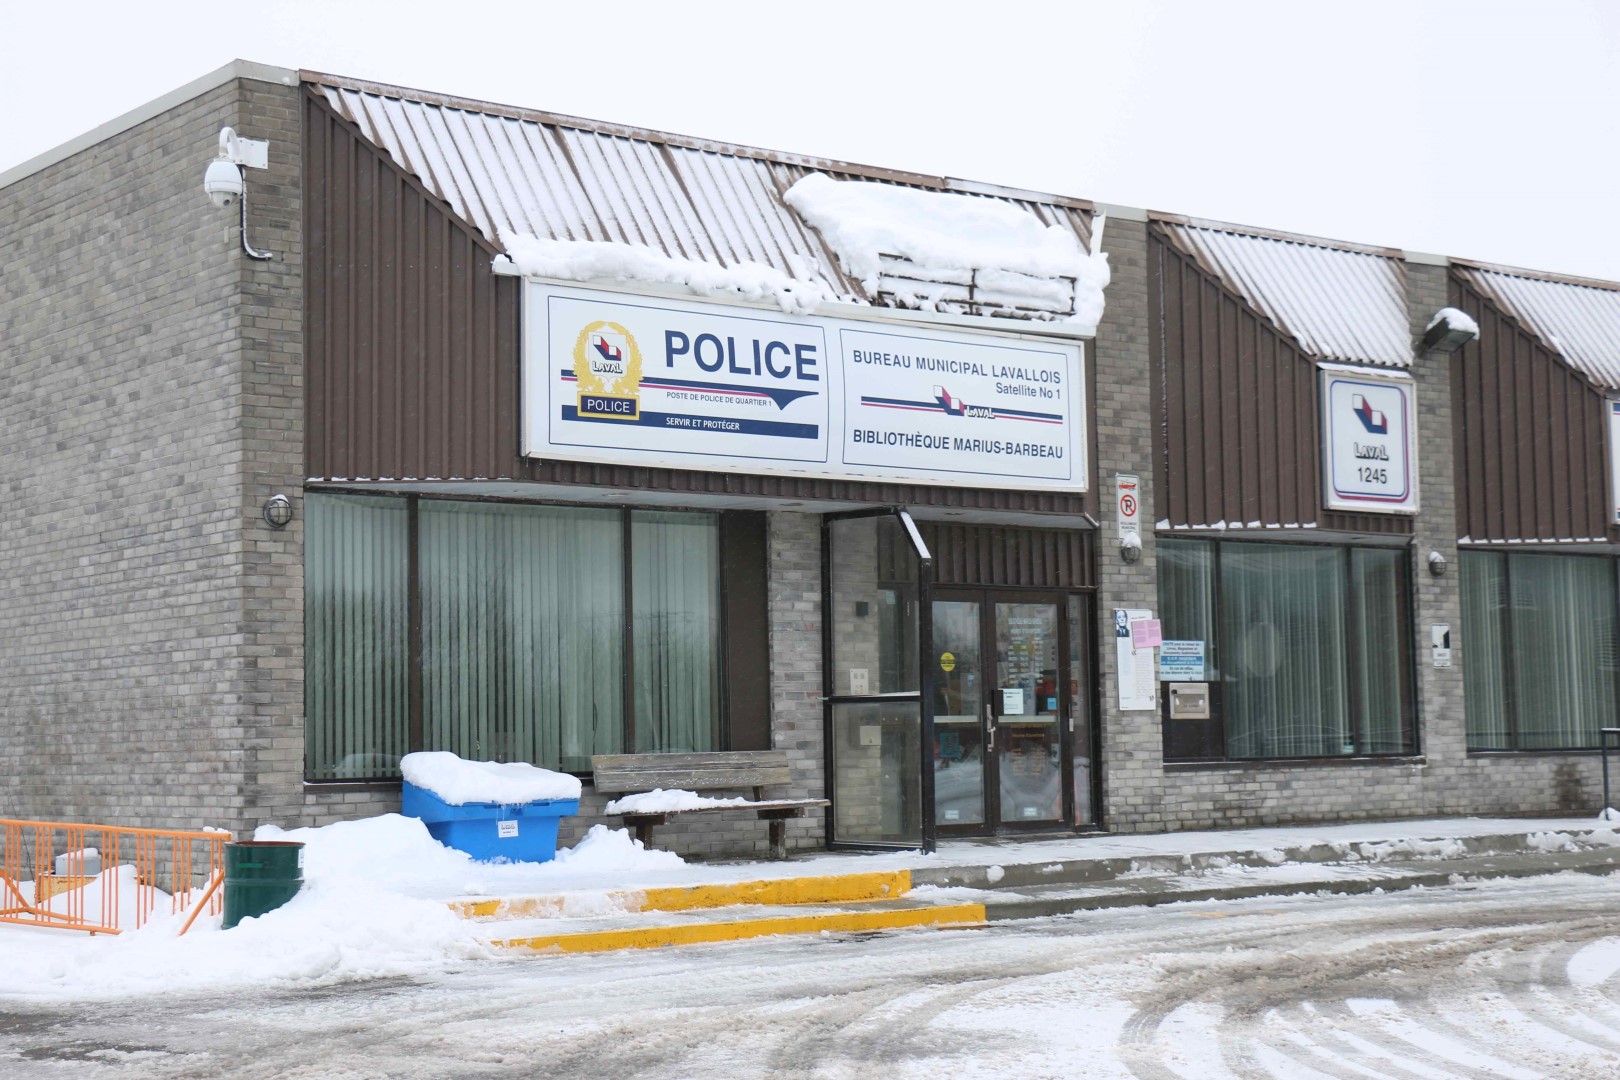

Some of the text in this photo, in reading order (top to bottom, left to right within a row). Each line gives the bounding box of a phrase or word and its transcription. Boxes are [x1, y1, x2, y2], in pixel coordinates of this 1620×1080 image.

[664, 329, 820, 382] POLICE
[592, 361, 624, 374] LAVAL
[853, 349, 1061, 384] BUREAU MUNICIPAL LAVALLOIS
[666, 391, 773, 407] POSTE DE POLICE DE QUARTIER 1
[996, 382, 1061, 399] Satellite No 1
[587, 400, 630, 413] POLICE
[966, 405, 996, 420] LAVAL
[666, 417, 740, 430] SERVIR ET PROTÉGER
[853, 429, 1063, 459] BIBLIOTHÈQUE MARIUS-BARBEAU
[1354, 443, 1389, 461] LAVAL
[1357, 466, 1388, 484] 1245
